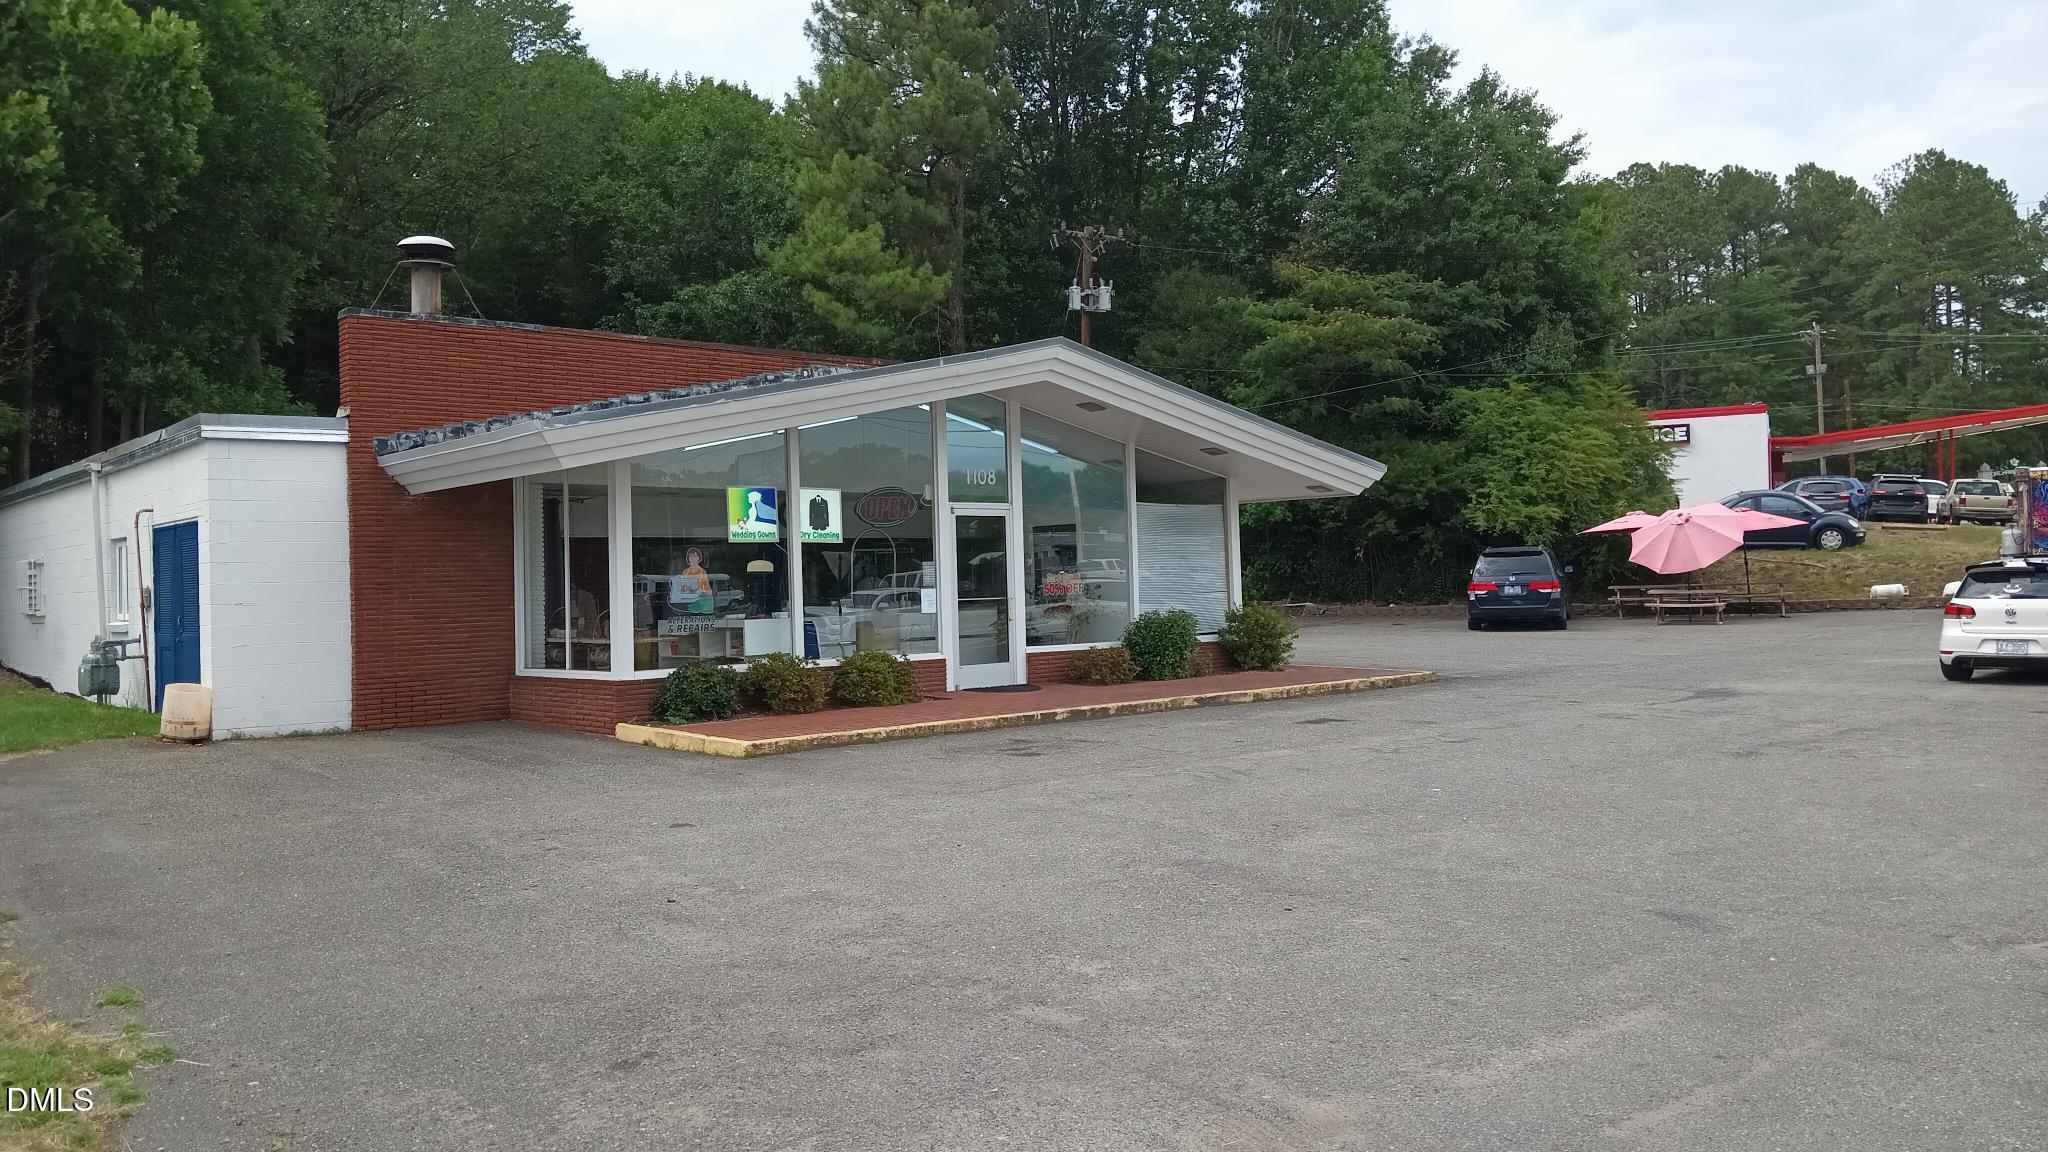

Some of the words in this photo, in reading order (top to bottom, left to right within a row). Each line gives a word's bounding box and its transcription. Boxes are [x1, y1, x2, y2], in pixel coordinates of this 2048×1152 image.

[966, 467, 997, 485] 1108
[864, 496, 911, 520] OPEN
[731, 530, 756, 539] Wedding
[757, 530, 776, 539] Gowns
[812, 531, 840, 540] Cleaning
[667, 616, 716, 624] ALTERATIONS
[667, 626, 675, 634] &
[676, 623, 716, 633] REPAIRS
